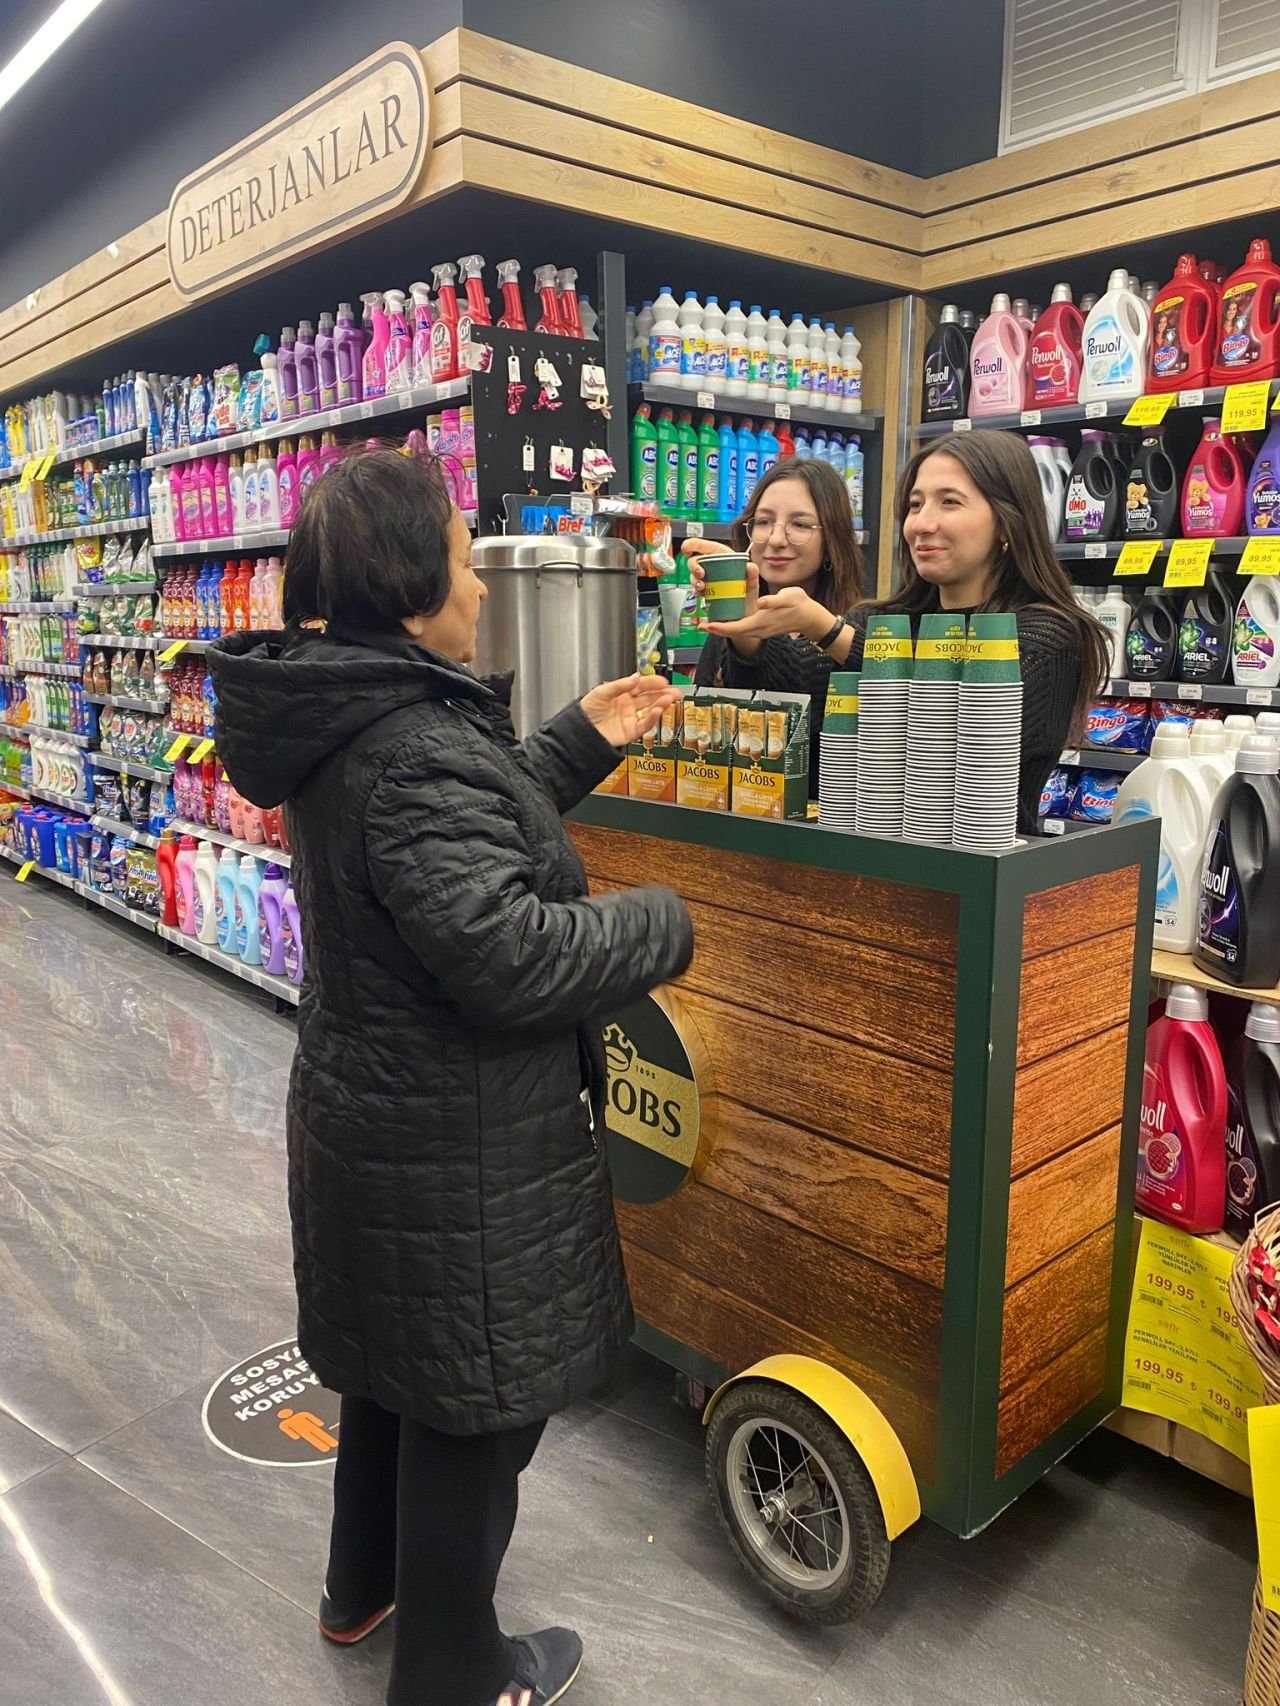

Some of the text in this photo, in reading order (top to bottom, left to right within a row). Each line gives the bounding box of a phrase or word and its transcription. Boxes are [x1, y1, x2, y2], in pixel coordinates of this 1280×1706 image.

[179, 94, 409, 264] DETERJANLAR
[1086, 335, 1122, 356] Perwoll
[1223, 337, 1250, 353] Bingo
[710, 356, 724, 367] ACE
[1031, 345, 1063, 365] Perwoll
[1154, 350, 1178, 362] Bingo
[973, 357, 1003, 376] Perwoll
[925, 366, 949, 384] Perwoll
[558, 517, 585, 533] Bref
[1183, 652, 1210, 662] ARIEL
[1236, 653, 1262, 662] ARIEL
[1087, 714, 1127, 730] Bingo
[633, 759, 668, 772] JACOBS
[683, 765, 720, 780] JACOBS
[738, 771, 776, 787] JACOBS
[635, 1065, 656, 1080] 1895
[610, 1077, 682, 1138] OBS
[1146, 1240, 1175, 1256] PERWOLL
[1146, 1272, 1195, 1301] 199,95
[1133, 1329, 1164, 1344] PERWOLL
[1134, 1357, 1184, 1385] 199,95
[229, 1359, 309, 1405] MESAF
[234, 1372, 320, 1422] KORUY
